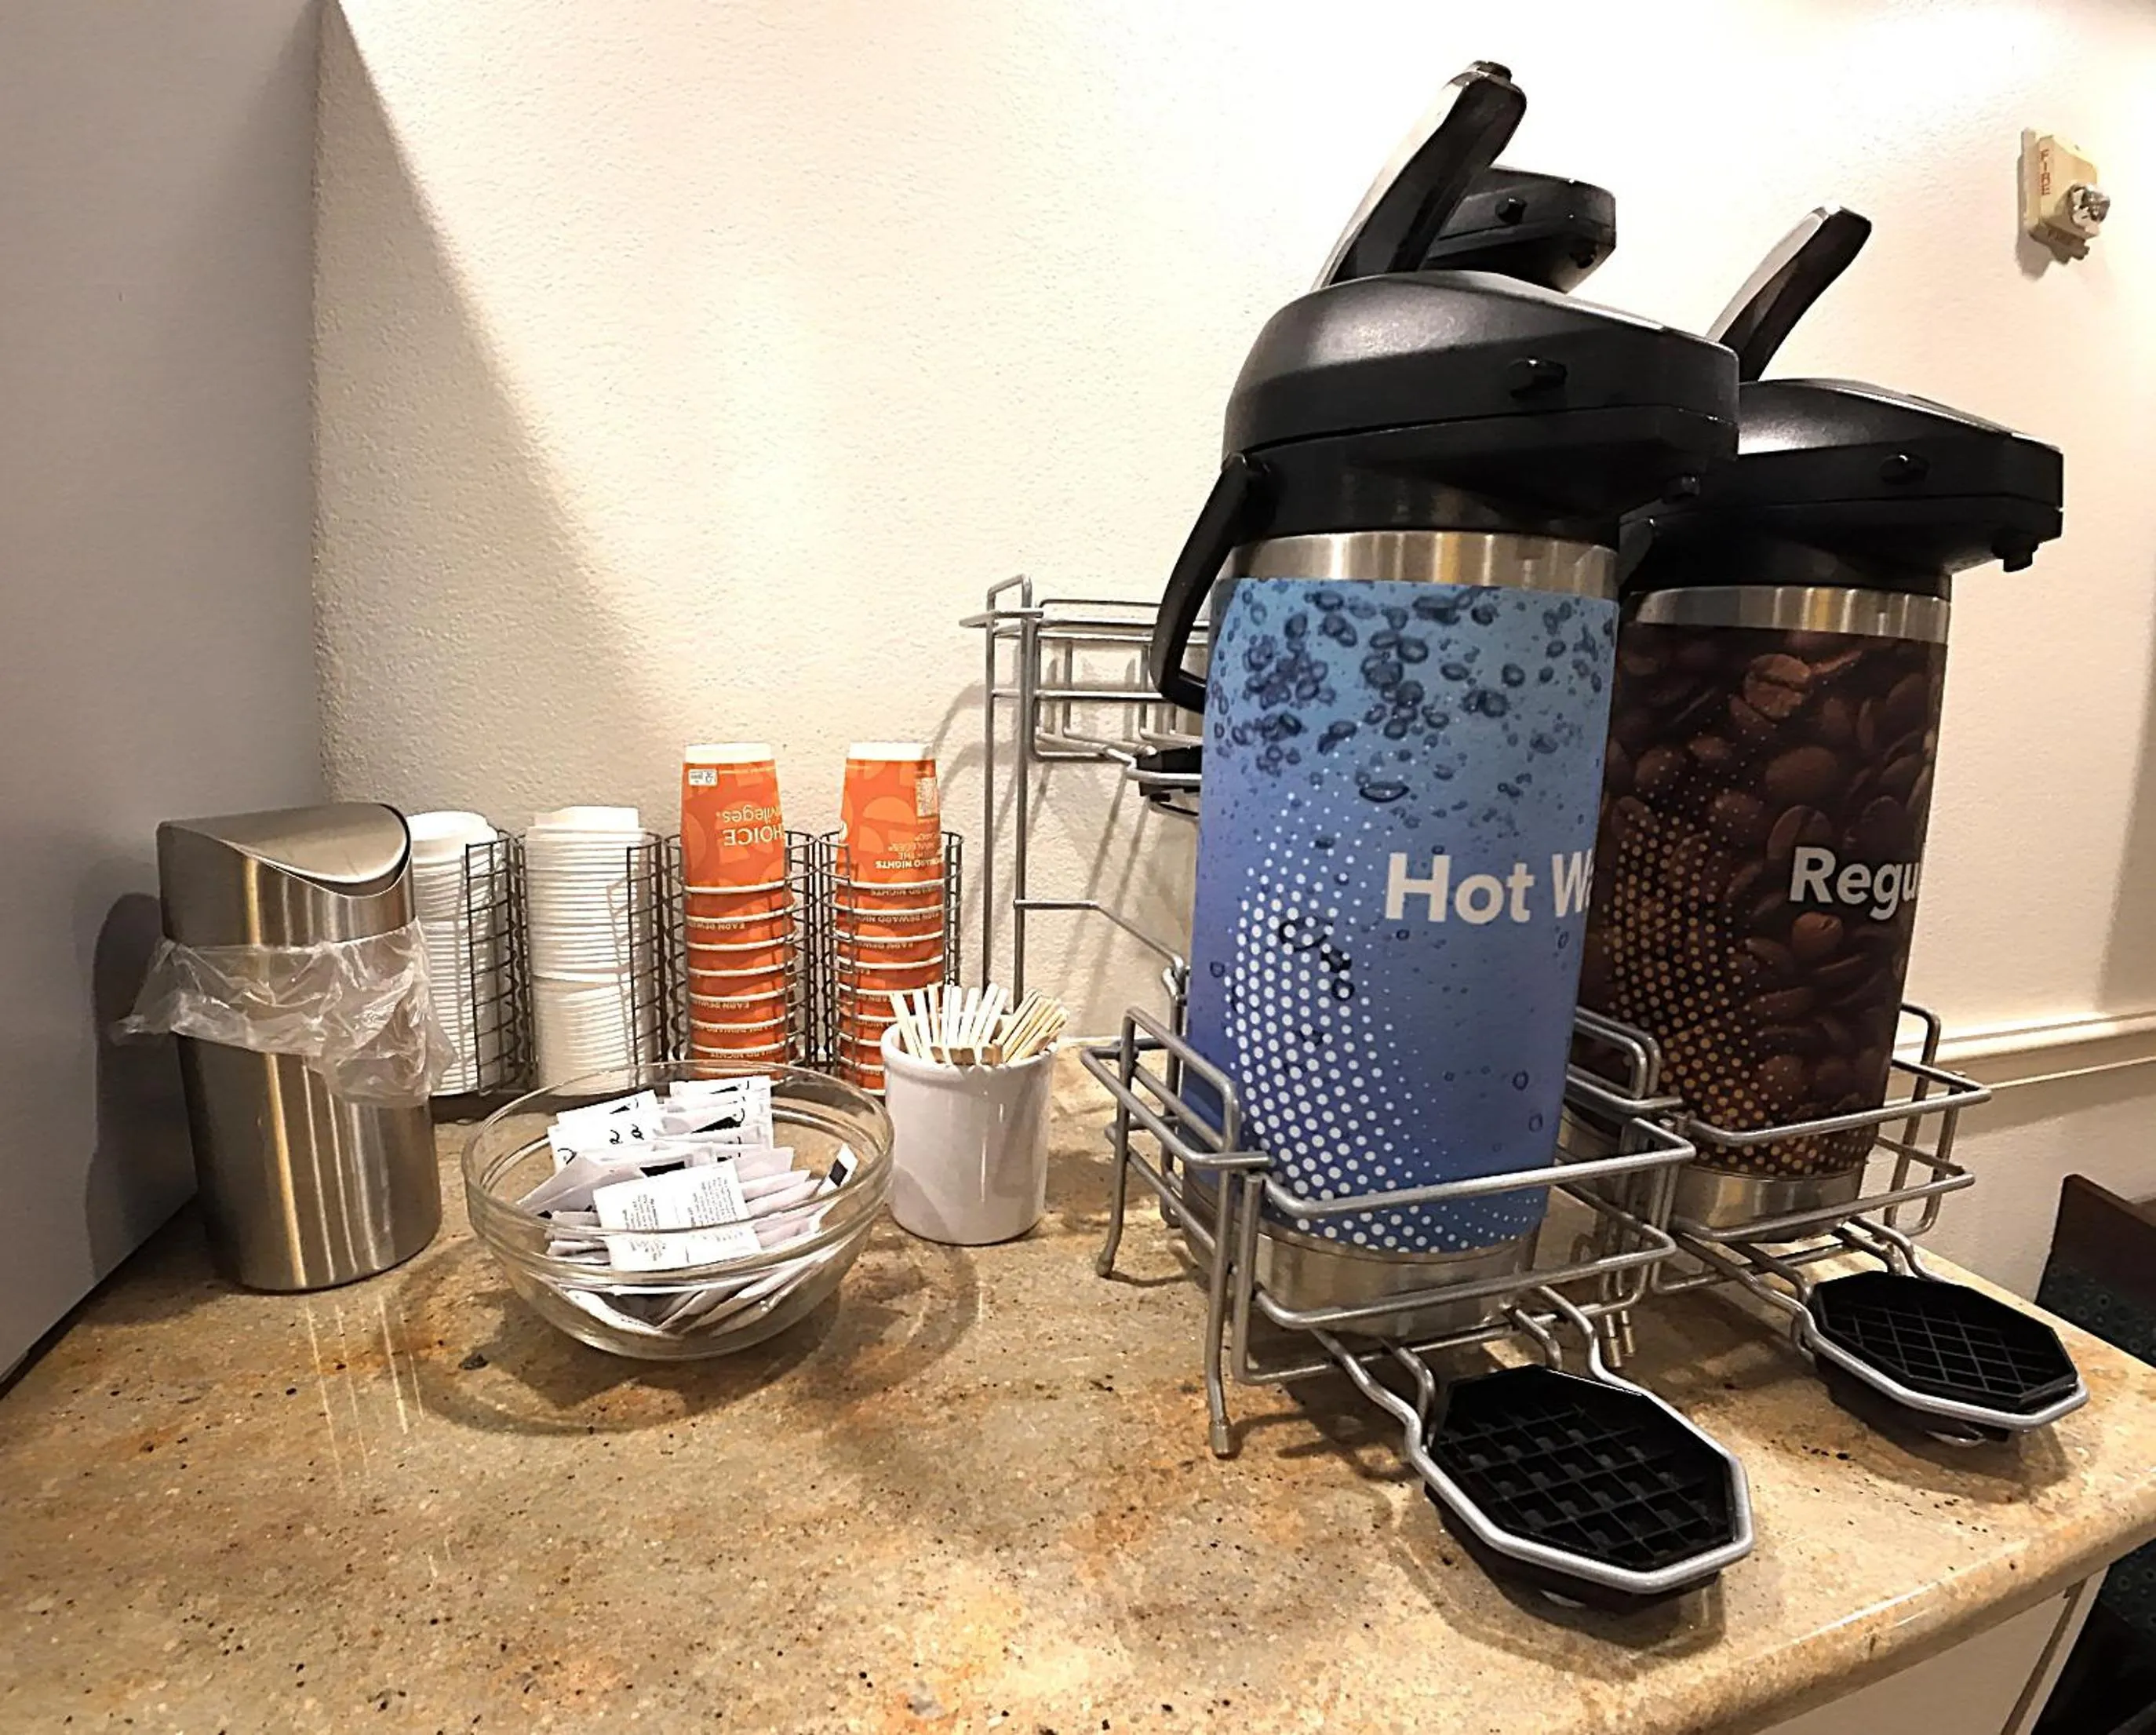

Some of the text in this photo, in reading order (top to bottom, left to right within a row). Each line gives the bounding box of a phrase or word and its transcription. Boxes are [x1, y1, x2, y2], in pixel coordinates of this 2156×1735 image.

[2039, 149, 2051, 196] FIRE
[723, 823, 785, 847] HOICE
[875, 860, 912, 869] NIGHTS
[1385, 852, 1535, 924] Hot
[1789, 846, 1921, 920] Regu
